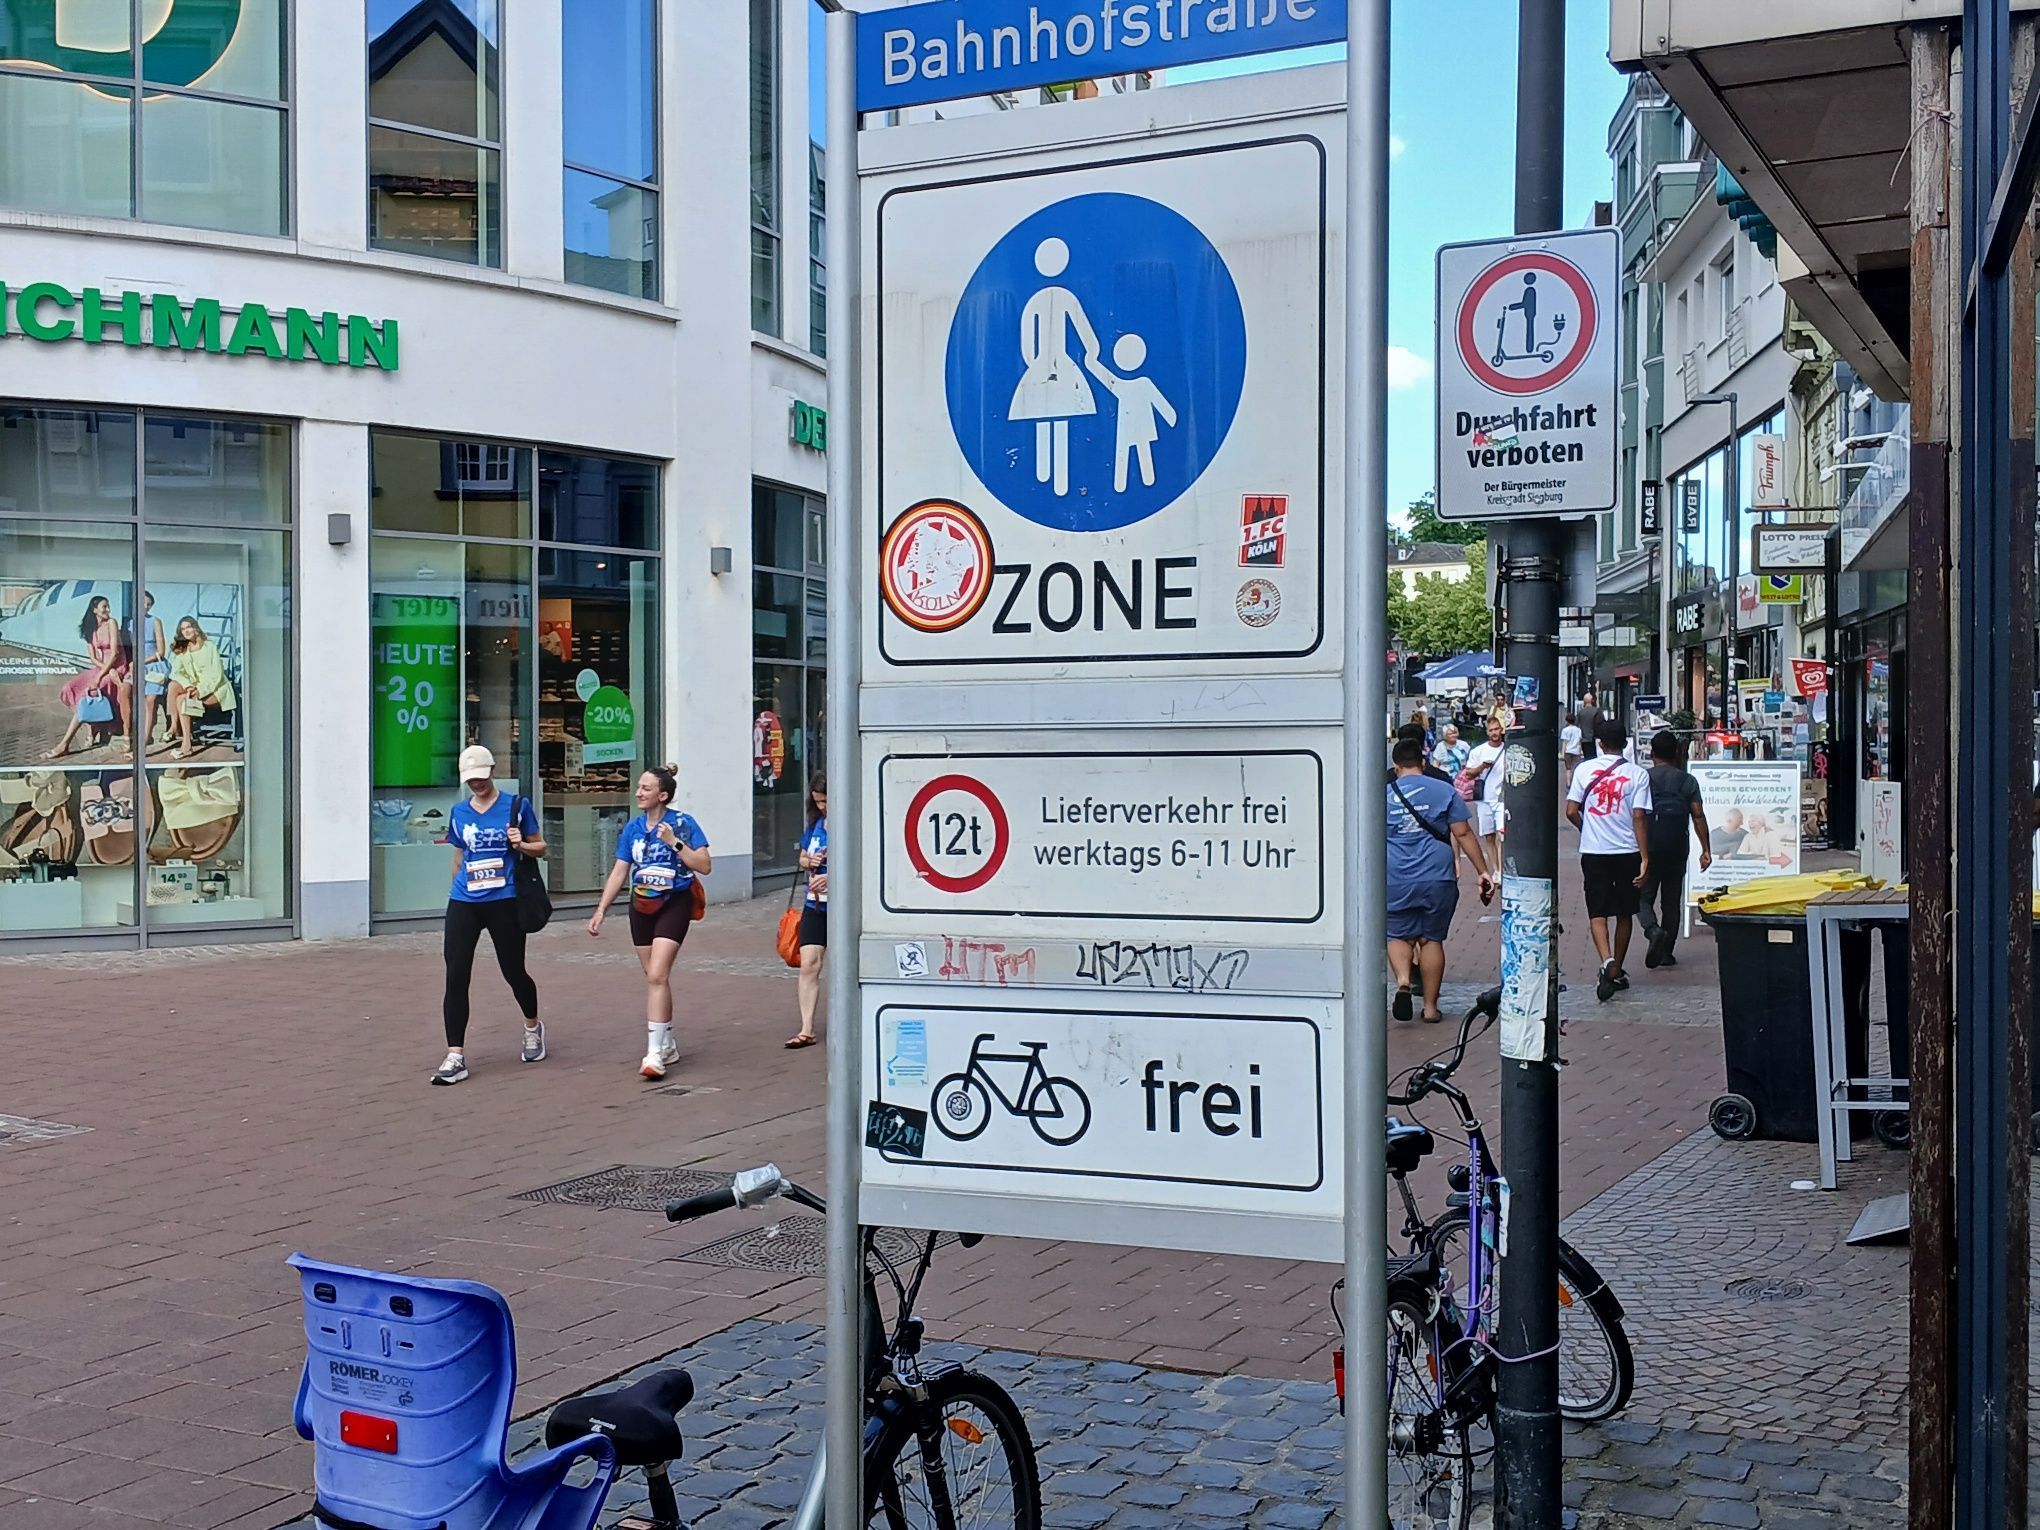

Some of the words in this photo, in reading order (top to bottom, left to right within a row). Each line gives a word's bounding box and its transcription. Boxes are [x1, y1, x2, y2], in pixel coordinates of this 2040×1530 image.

[1467, 441, 1584, 468] verboten
[1758, 443, 1780, 499] Triumph
[1484, 482, 1500, 492] Der
[1501, 479, 1566, 493] Bürgermeister
[1644, 486, 1655, 528] RABE
[1247, 540, 1277, 558] KÖLN
[992, 556, 1197, 633] ZONE
[1676, 603, 1698, 633] RABE
[587, 706, 631, 723] -20%
[596, 747, 624, 757] SOCKEN
[1042, 796, 1234, 825] Lieferverkehr
[1242, 796, 1288, 826] frei
[929, 812, 982, 856] 12t
[1033, 838, 1162, 874] werktags
[1171, 839, 1230, 867] 6-11
[1243, 840, 1297, 869] Uhr
[474, 868, 496, 880] 1932
[642, 875, 666, 886] 1924
[1141, 1060, 1262, 1139] frei
[329, 1360, 380, 1382] RÖMER
